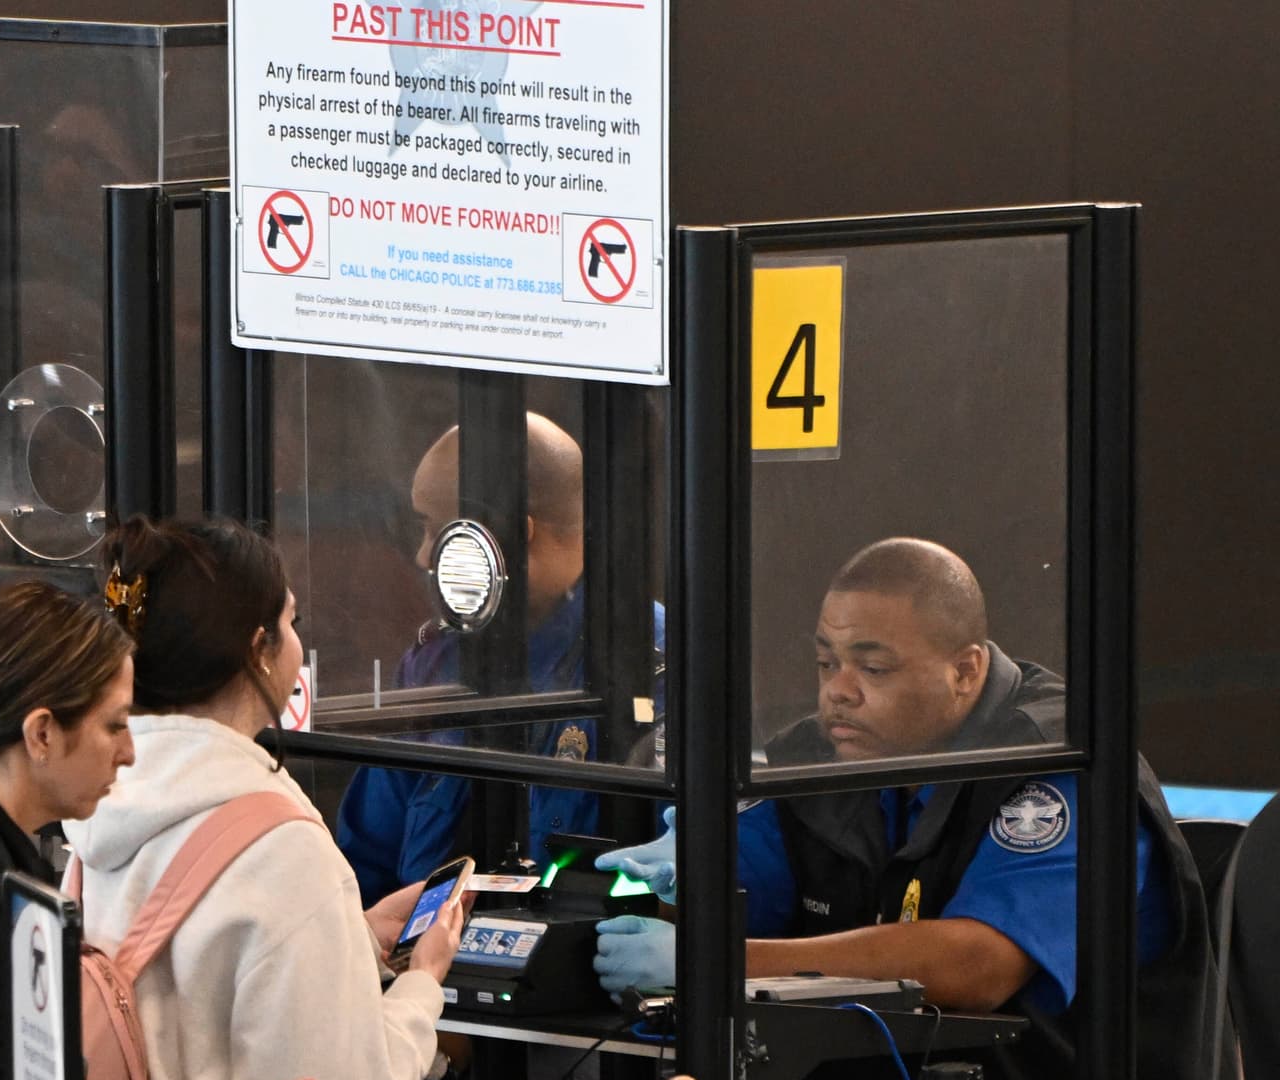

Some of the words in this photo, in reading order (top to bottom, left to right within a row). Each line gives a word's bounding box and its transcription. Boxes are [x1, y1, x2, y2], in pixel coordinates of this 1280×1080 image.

[333, 3, 402, 37] PAST
[410, 8, 470, 42] THIS
[479, 13, 561, 48] POINT
[266, 61, 293, 84] Any
[297, 63, 346, 83] firearm
[350, 67, 390, 87] found
[395, 72, 445, 93] beyond
[451, 75, 476, 94] this
[480, 78, 516, 97] point
[521, 81, 544, 98] will
[548, 84, 589, 102] result
[593, 86, 605, 103] in
[610, 87, 632, 105] the
[258, 92, 315, 113] physical
[320, 99, 360, 115] arrest
[364, 99, 378, 116] of
[382, 102, 403, 118] the
[407, 101, 456, 121] bearer.
[460, 105, 478, 123] All
[482, 107, 540, 128] firearms
[545, 113, 606, 137] traveling
[611, 117, 640, 136] with
[268, 123, 276, 137] a
[280, 123, 352, 146] passenger
[356, 130, 389, 146] must
[394, 129, 410, 147] be
[415, 134, 482, 156] packaged
[487, 141, 552, 162] correctly,
[557, 146, 613, 164] secured
[618, 148, 631, 165] in
[291, 152, 348, 172] checked
[352, 156, 407, 180] luggage
[412, 163, 437, 179] and
[442, 164, 501, 184] declared
[506, 170, 519, 185] to
[524, 174, 556, 190] your
[560, 174, 607, 193] airline.
[330, 197, 354, 218] DO
[360, 199, 396, 222] NOT
[402, 203, 452, 226] MOVE
[458, 207, 560, 235] FORWARD!!
[340, 263, 368, 278] CALL
[371, 267, 386, 280] the
[390, 268, 439, 284] CHICAGO
[442, 272, 481, 288] POLICE
[484, 277, 494, 289] at
[387, 244, 396, 258] If
[399, 249, 419, 263] you
[422, 249, 449, 263] need
[453, 252, 513, 269] assistance
[766, 323, 825, 433] 4
